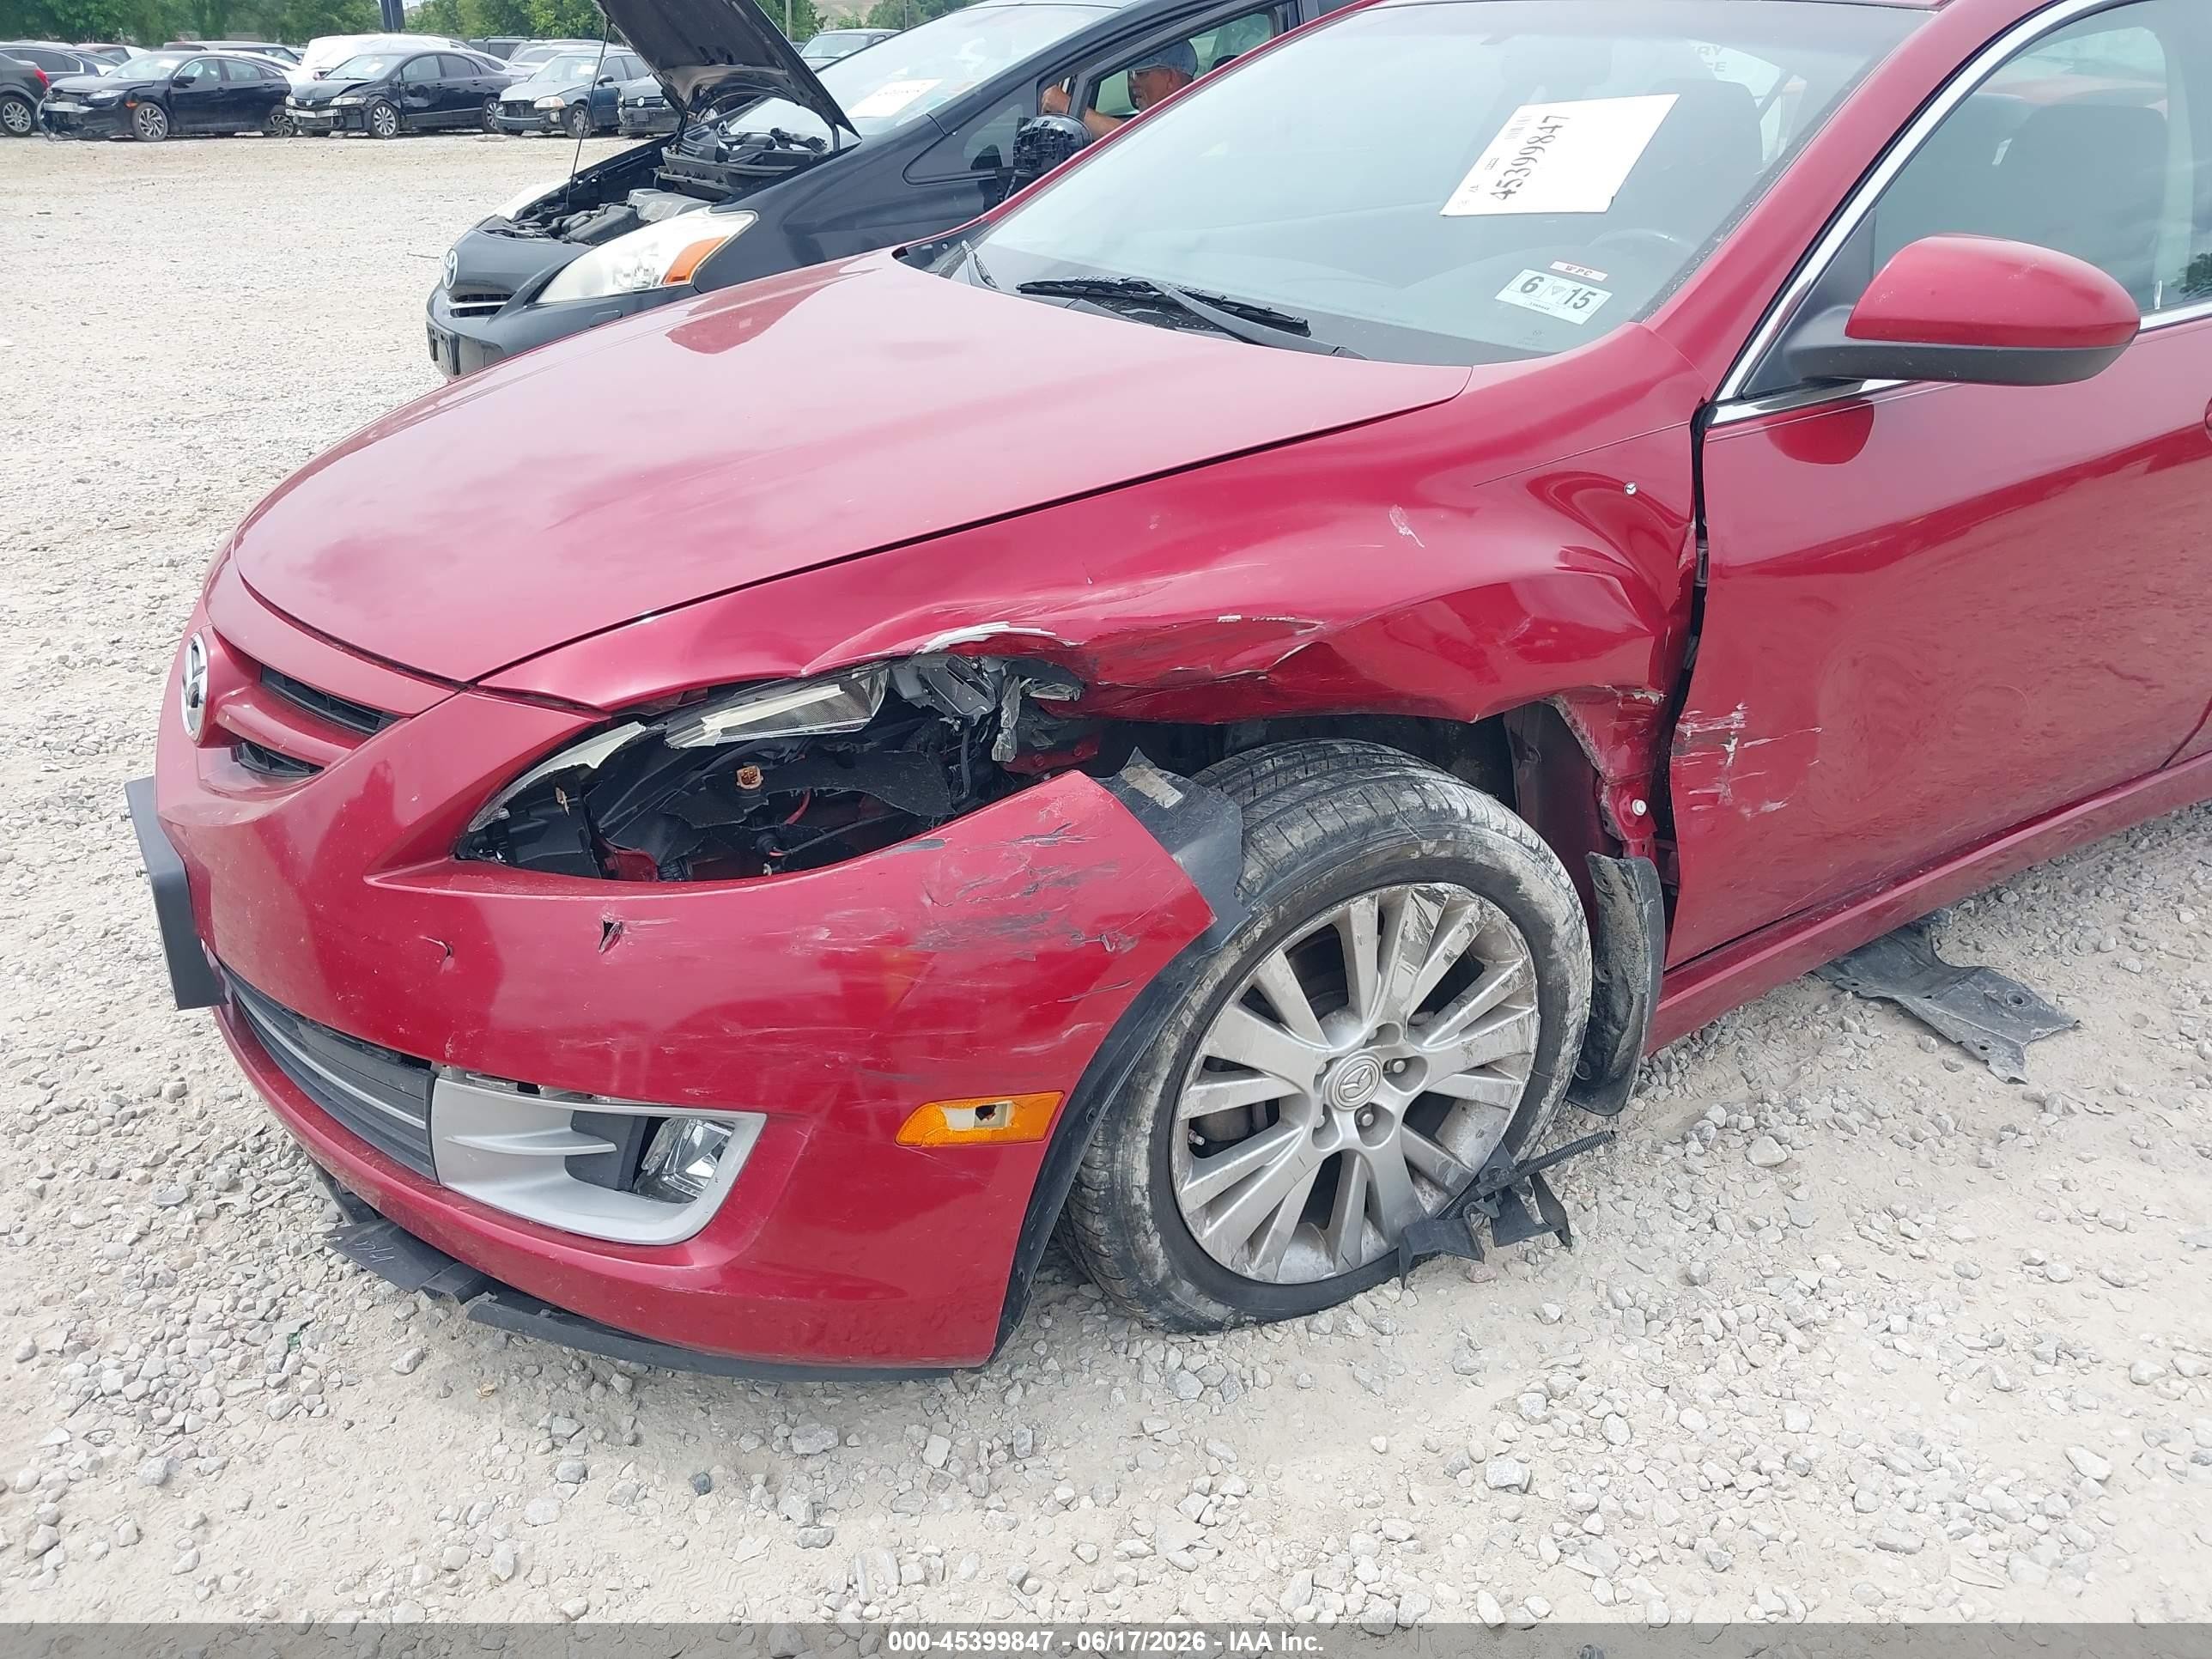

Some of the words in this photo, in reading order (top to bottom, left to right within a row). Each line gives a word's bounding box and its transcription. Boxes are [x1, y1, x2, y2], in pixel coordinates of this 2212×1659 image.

[1491, 115, 1571, 201] 45399847
[1520, 276, 1545, 294] 6
[1564, 287, 1597, 310] 15
